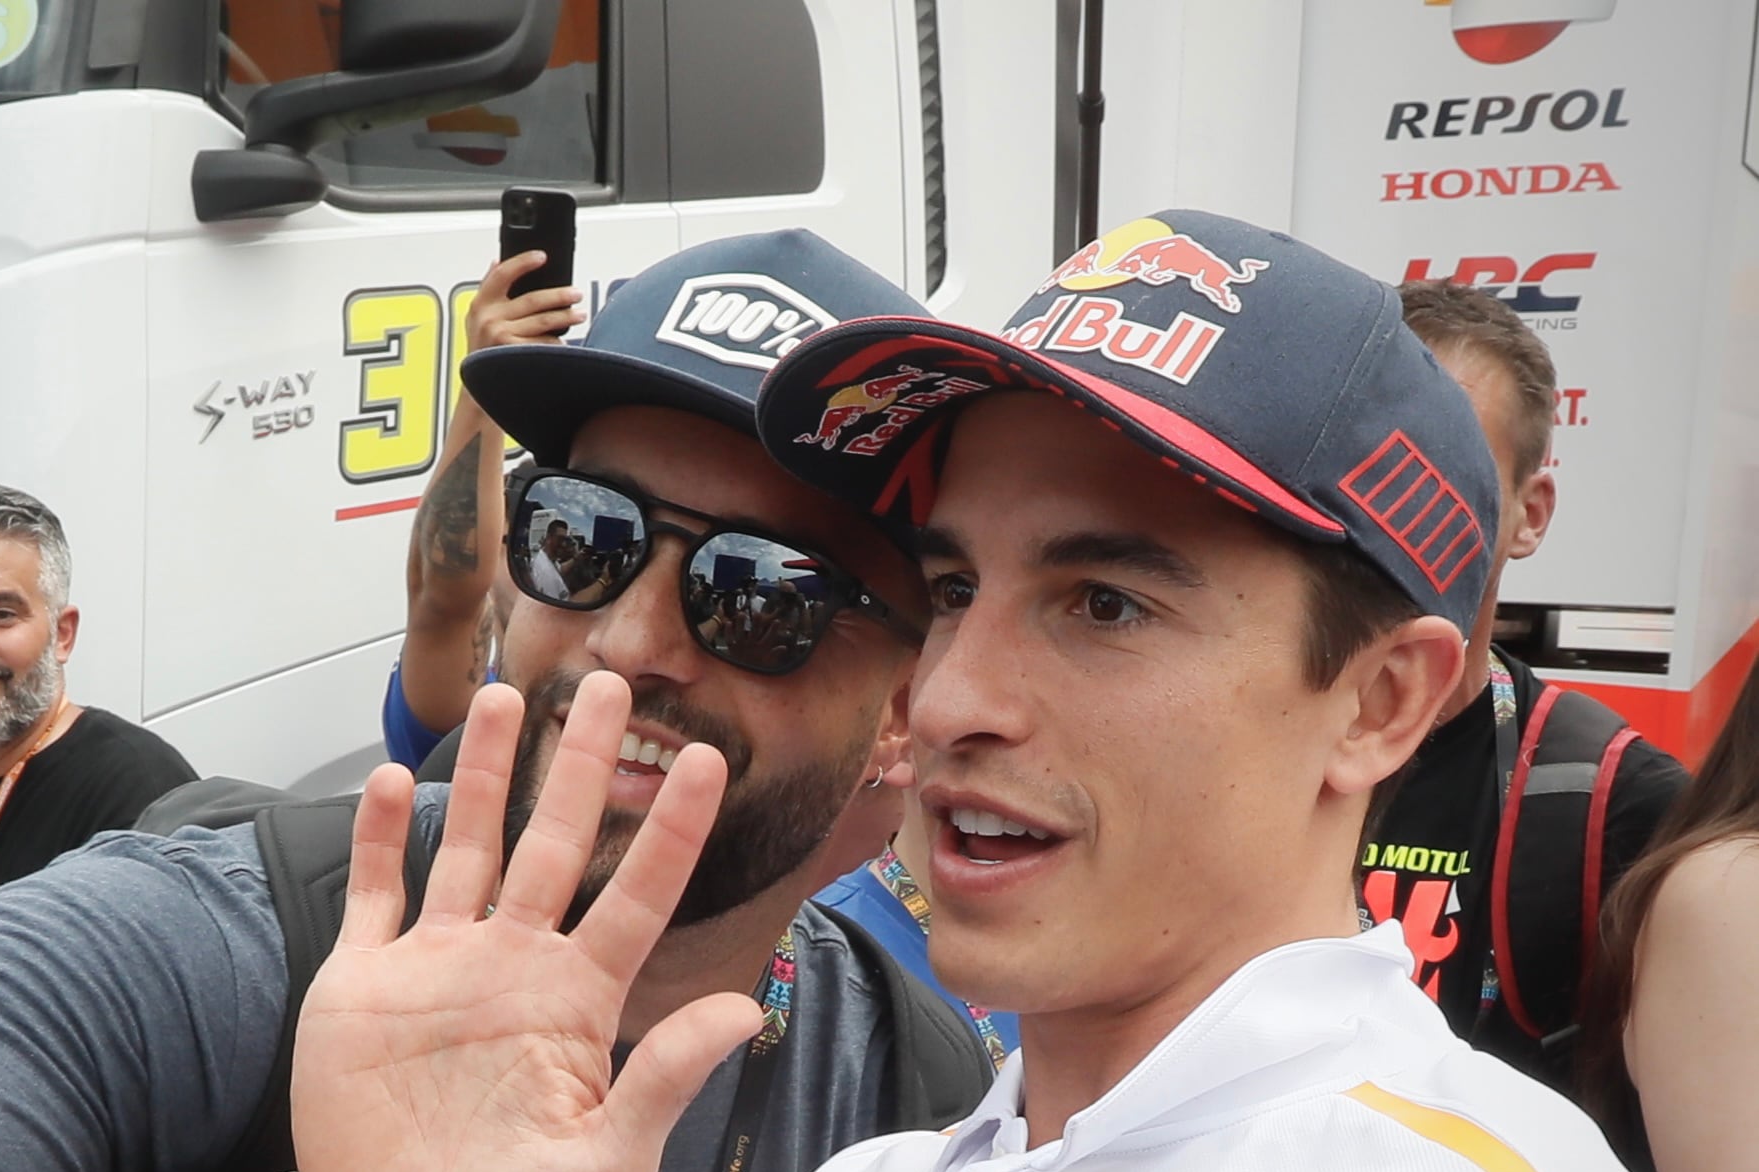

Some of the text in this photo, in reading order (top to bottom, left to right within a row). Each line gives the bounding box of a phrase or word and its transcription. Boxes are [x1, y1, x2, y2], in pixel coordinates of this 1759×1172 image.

[1385, 88, 1630, 140] REPSOL
[1379, 162, 1622, 202] HONDA
[679, 290, 816, 357] 100%
[1048, 297, 1224, 385] Bull
[251, 404, 315, 440] 530
[842, 406, 924, 456] Red
[1380, 844, 1471, 876] MOTUL
